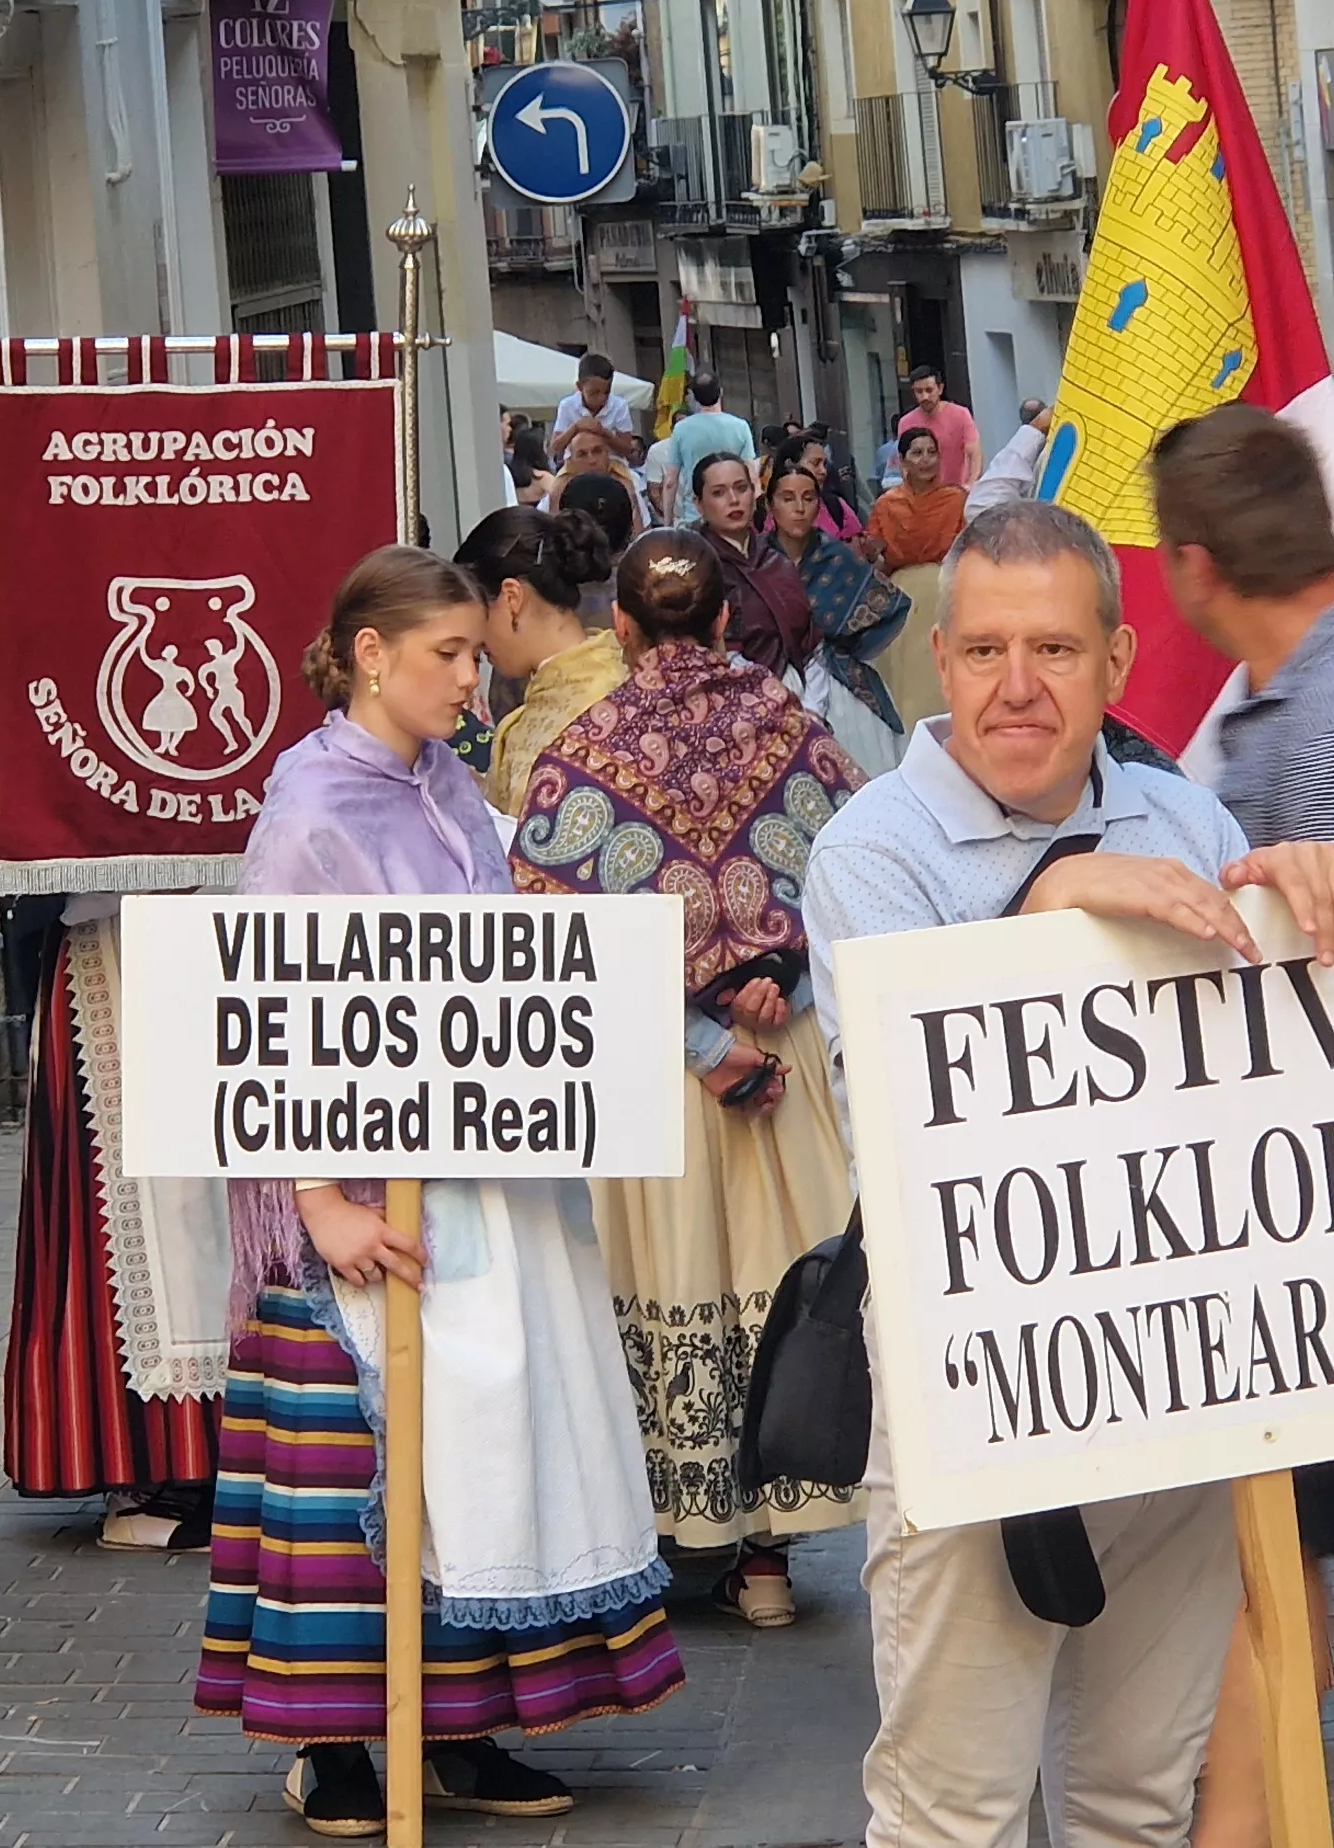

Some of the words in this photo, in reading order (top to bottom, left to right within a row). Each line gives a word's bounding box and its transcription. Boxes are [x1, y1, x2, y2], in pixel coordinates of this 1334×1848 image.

[219, 17, 321, 50] COLORES
[220, 52, 319, 80] PELUQUERÍA
[235, 81, 317, 110] SEÑORAS
[42, 418, 315, 461] AGRUPACIÓN
[47, 466, 310, 506] FOLKLÓRICA
[28, 677, 140, 812] SEÑORA
[146, 788, 203, 824] DE
[208, 787, 264, 823] LA
[212, 912, 597, 983] VILLARRUBIA
[216, 997, 289, 1067] DE
[311, 995, 419, 1069] LOS
[440, 995, 594, 1069] OJOS
[213, 1080, 429, 1168] (Ciudad
[453, 1080, 597, 1168] Real)
